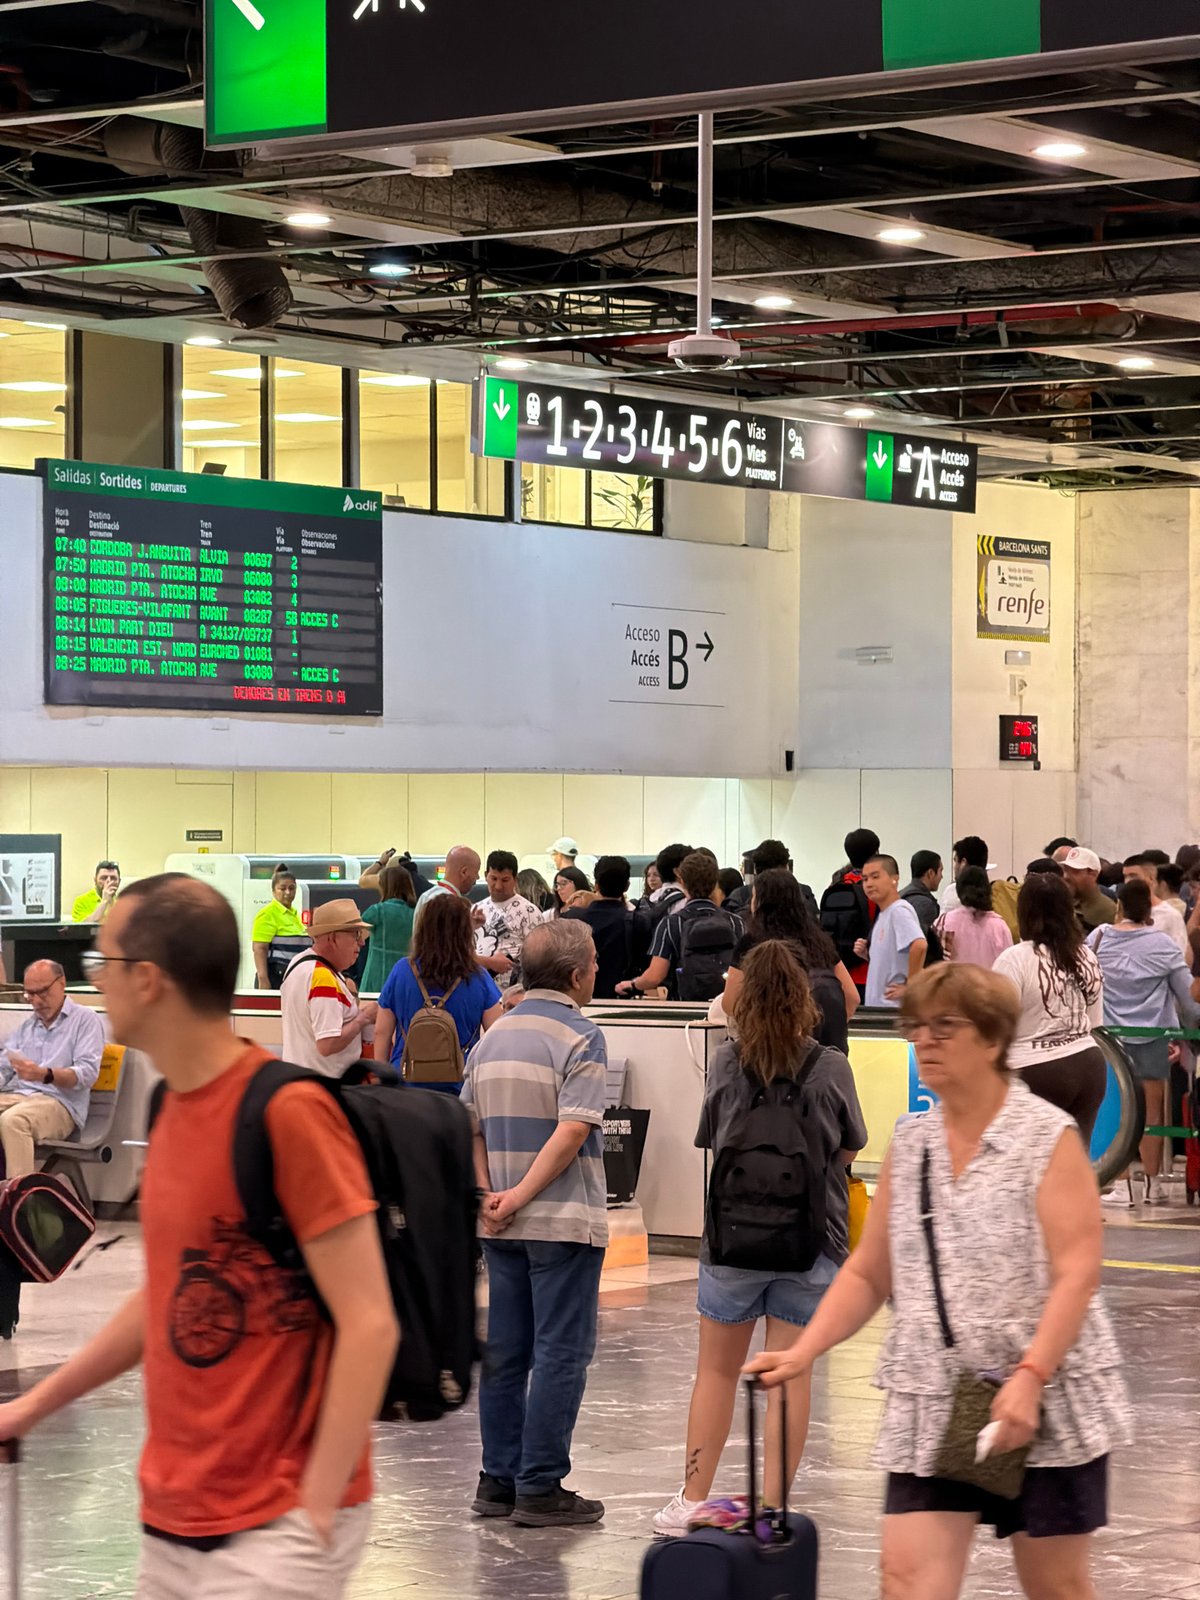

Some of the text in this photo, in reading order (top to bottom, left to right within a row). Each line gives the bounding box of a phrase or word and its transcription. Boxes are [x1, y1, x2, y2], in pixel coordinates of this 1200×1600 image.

[747, 421, 765, 440] Vías
[747, 444, 766, 462] Vies
[940, 448, 969, 466] Acceso
[54, 467, 186, 493] Salidas Sortides DEPARTURES
[915, 446, 936, 500] A
[939, 469, 964, 487] Accés
[354, 499, 377, 511] adif
[55, 517, 69, 526] Hora
[89, 520, 119, 531] Destinació
[200, 529, 212, 538] Tren
[301, 538, 335, 549] Observacions
[89, 510, 110, 520] Destino
[200, 520, 211, 528] Tren
[301, 530, 337, 540] Observaciones
[55, 537, 86, 553] 07:40
[89, 539, 132, 557] CORDOBA
[136, 543, 191, 562] J.ANGUITA
[199, 548, 228, 565] ALVIA
[290, 555, 297, 570] 2
[998, 542, 1048, 555] BARCELONA SANTS
[55, 556, 86, 572] 07:50
[89, 558, 126, 576] MADRID
[130, 561, 154, 578] PTA.
[160, 564, 196, 581] ATOCHA
[199, 567, 222, 583] IRYO
[290, 573, 297, 588] 3
[55, 576, 86, 592] 08:00
[89, 578, 126, 595] MADRID
[130, 581, 154, 597] PTA.
[160, 583, 196, 600] ATOCHA
[199, 585, 217, 602] AVE
[290, 591, 297, 607] 4
[55, 595, 86, 612] 08:05
[89, 598, 191, 619] FIGUERES-VILAFANT
[199, 605, 228, 621] AVANT
[300, 612, 328, 627] ACCES
[331, 613, 338, 628] C
[997, 588, 1045, 625] renfe
[55, 615, 86, 632] 08:14
[89, 617, 114, 634] LYON
[118, 620, 144, 636] PART
[148, 621, 173, 637] DIEU
[199, 624, 205, 639] A
[291, 629, 297, 643] 1
[625, 623, 660, 642] Acceso
[55, 635, 86, 651] 08:15
[89, 637, 138, 655] VALENCIA
[142, 640, 166, 656] EST.
[171, 642, 196, 657] NORD
[199, 643, 239, 659] EUROMED
[631, 649, 660, 667] Accés
[668, 628, 689, 690] B
[55, 654, 86, 671] 08:25
[89, 657, 126, 673] MADRID
[130, 659, 154, 674] PTA.
[160, 661, 196, 676] ATOCHA
[199, 662, 217, 678] AVE
[300, 666, 329, 682] ACCES
[331, 668, 339, 683] C
[638, 675, 660, 687] ACCESS
[277, 687, 290, 702] EN
